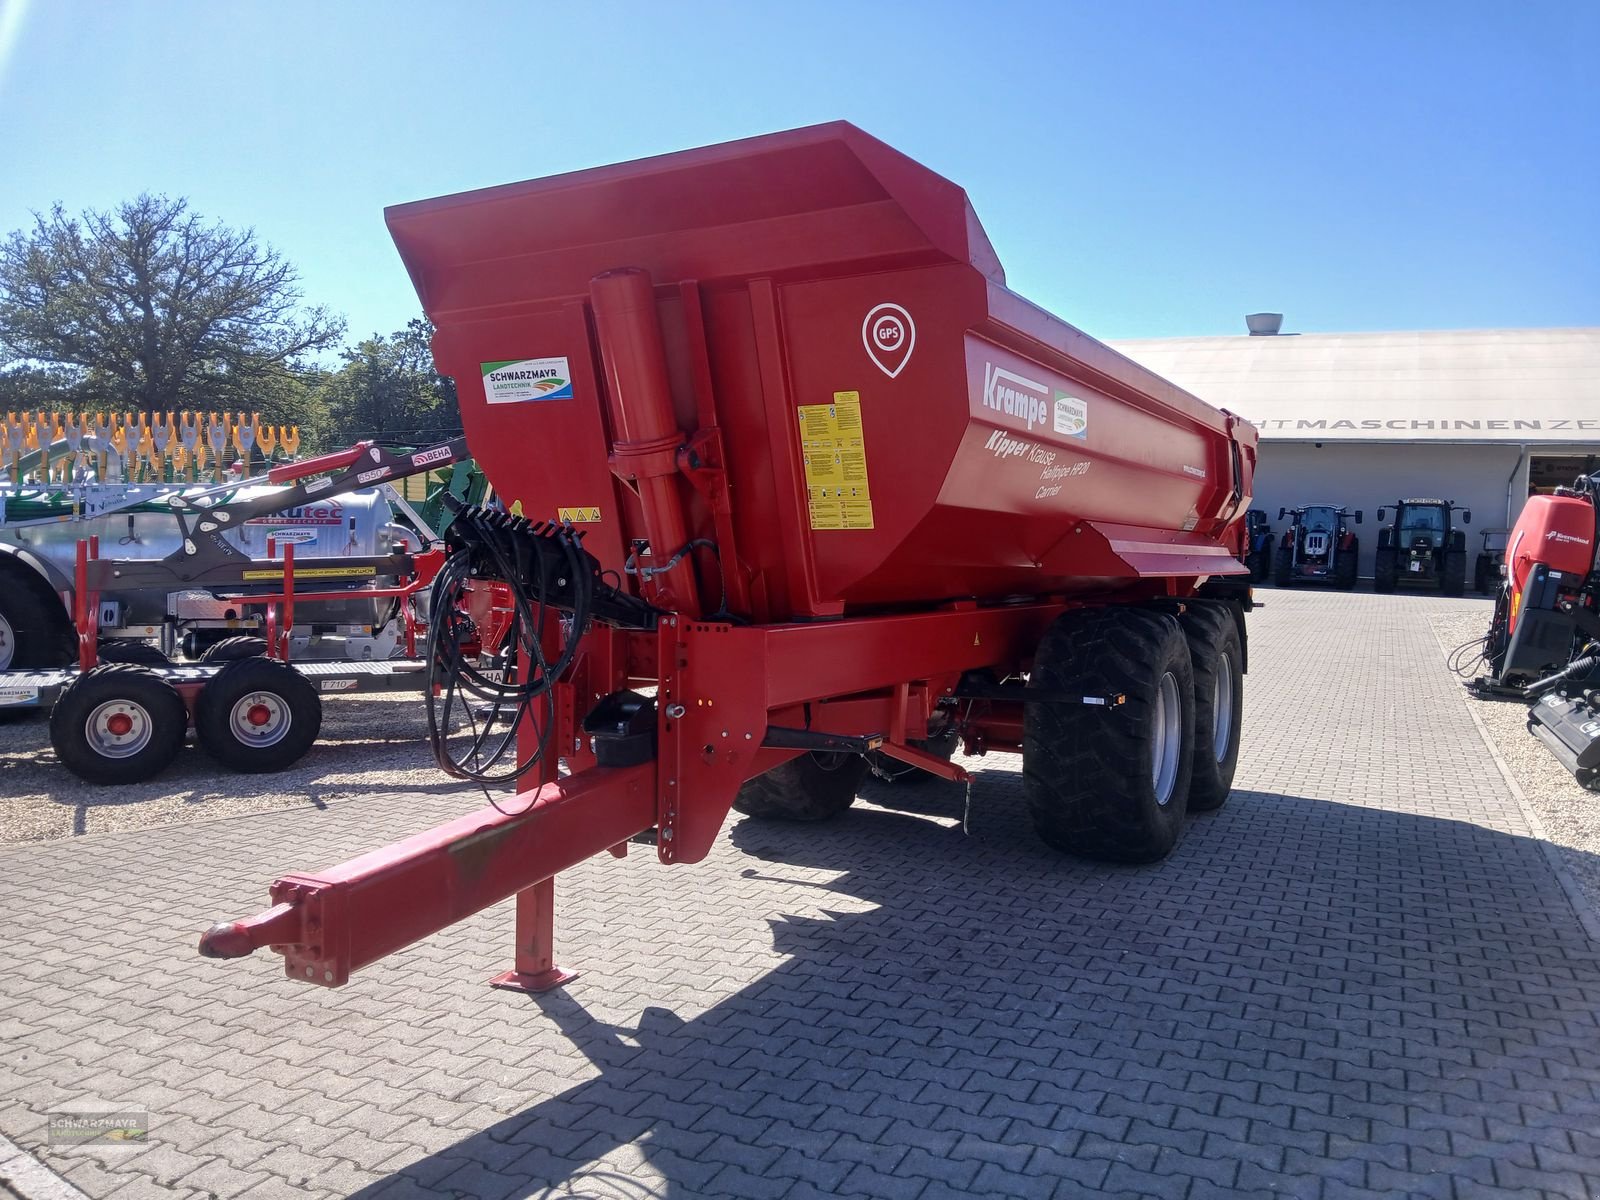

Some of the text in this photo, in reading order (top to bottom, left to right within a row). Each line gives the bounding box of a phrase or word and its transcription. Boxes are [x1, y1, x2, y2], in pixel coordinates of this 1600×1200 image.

[879, 326, 899, 340] GPS
[490, 368, 557, 382] SCHWARZMAYR
[493, 382, 532, 390] LANDTECHNIK
[983, 361, 1049, 431] Krampe
[427, 448, 451, 461] BEHA
[985, 429, 1056, 466] Kipper Krause
[358, 469, 383, 482] 6550
[1039, 461, 1091, 481] Halfpipe HP20
[1035, 484, 1062, 499] Carrier
[1557, 532, 1590, 545] Kverneland
[330, 681, 346, 689] 710
